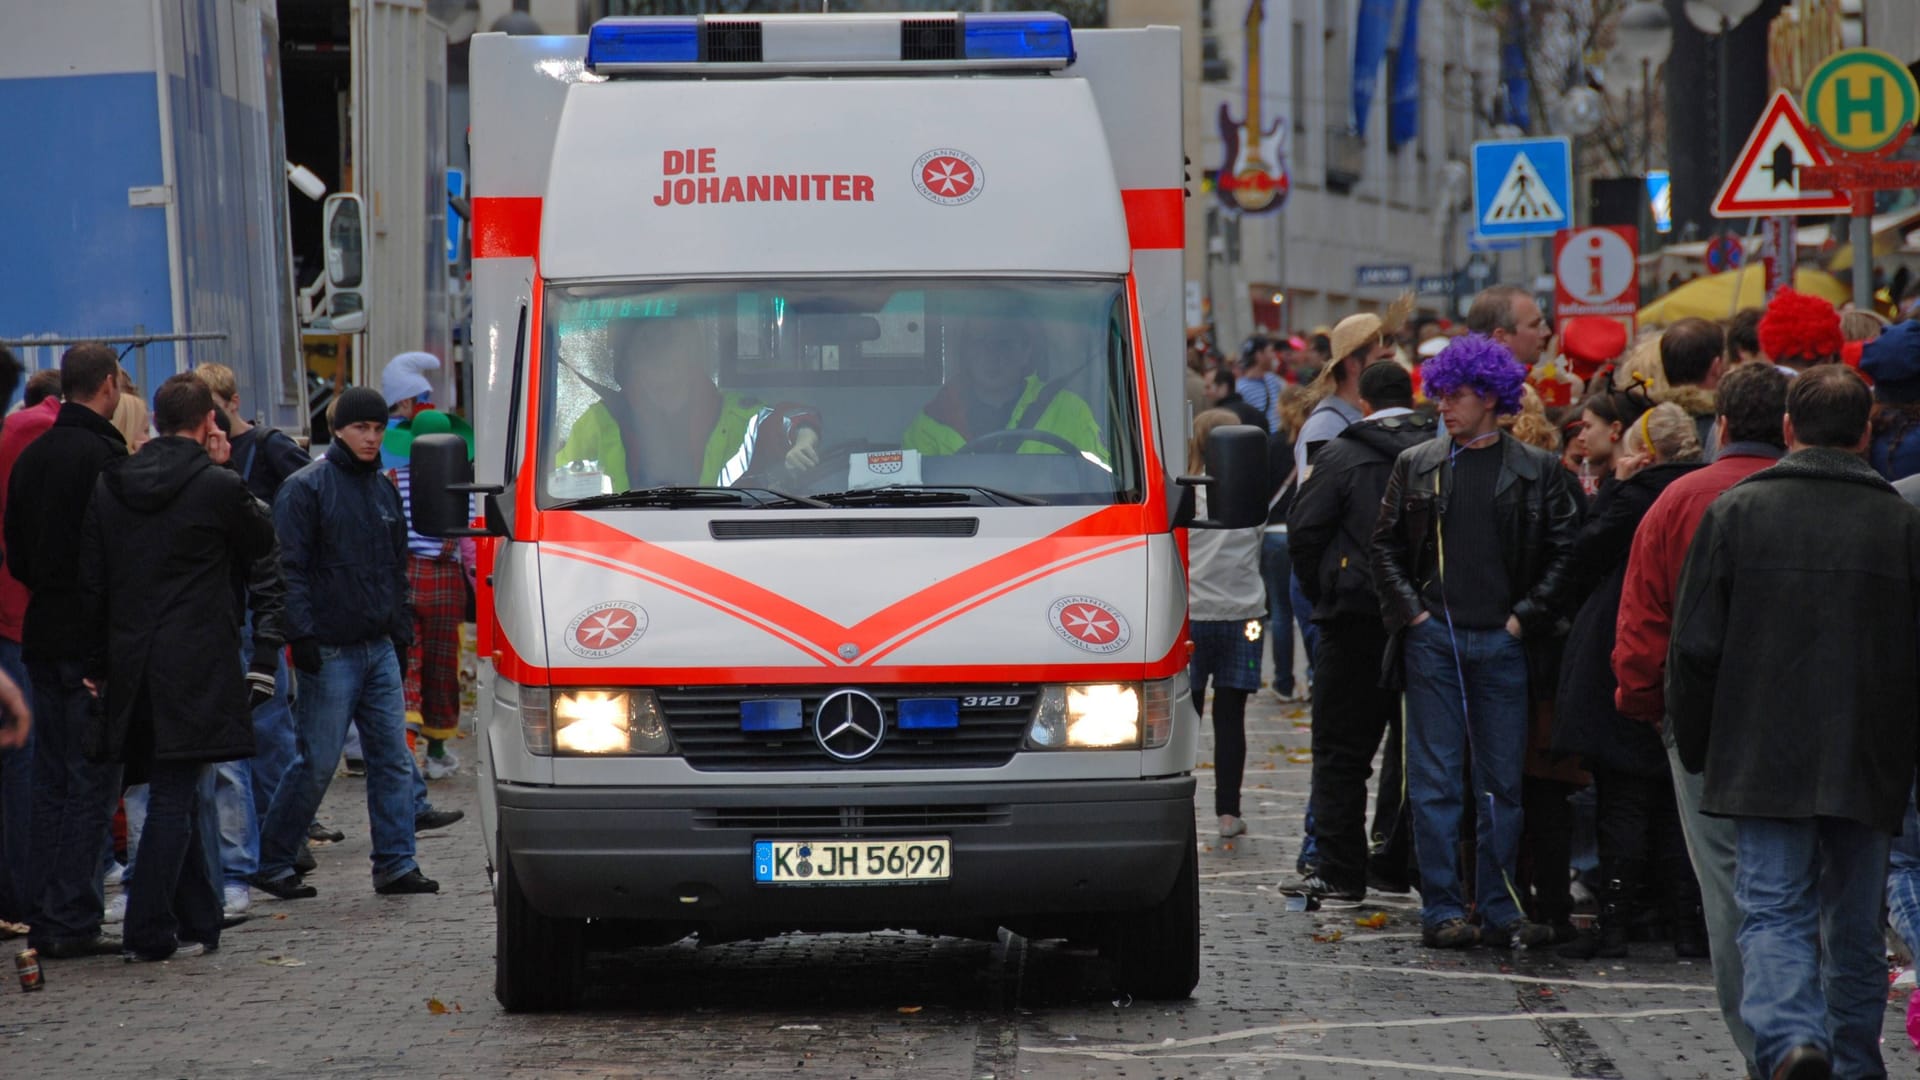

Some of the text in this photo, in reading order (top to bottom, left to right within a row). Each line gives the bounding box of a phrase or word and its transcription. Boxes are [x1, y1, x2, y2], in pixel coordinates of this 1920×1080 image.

[1835, 76, 1886, 135] H
[663, 148, 716, 176] DIE
[653, 174, 875, 207] JOHANNITER
[760, 865, 768, 874] D
[775, 844, 945, 877] K JH 5699
